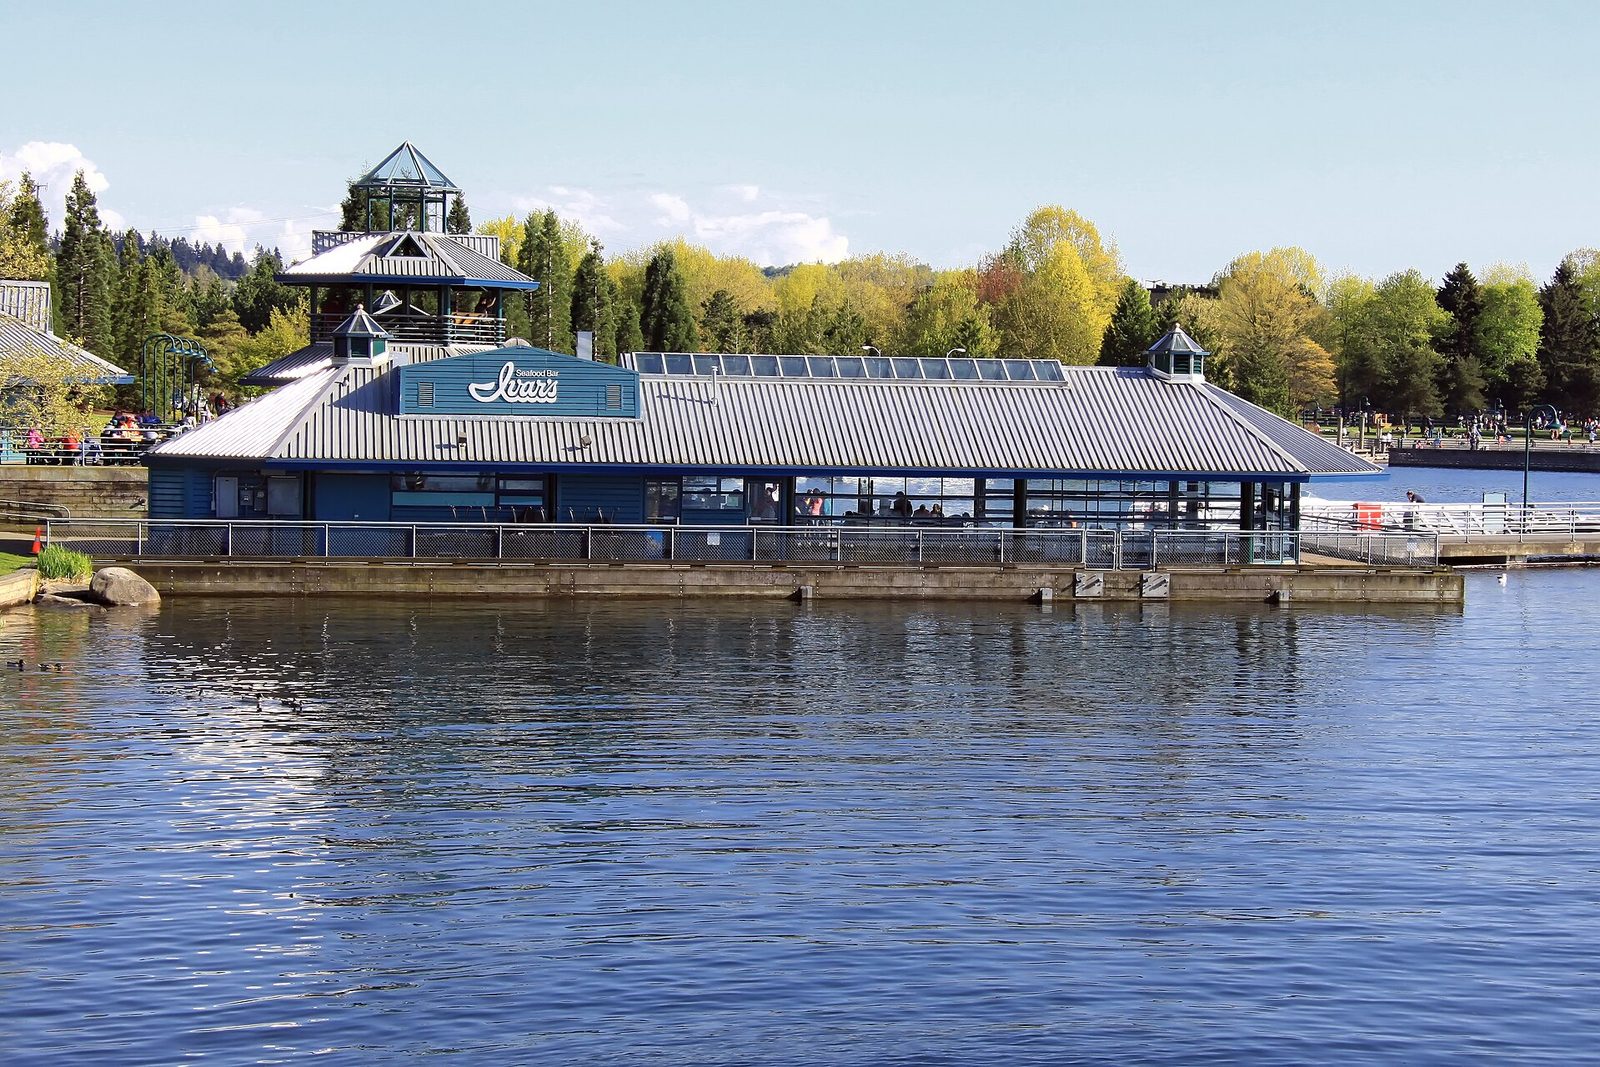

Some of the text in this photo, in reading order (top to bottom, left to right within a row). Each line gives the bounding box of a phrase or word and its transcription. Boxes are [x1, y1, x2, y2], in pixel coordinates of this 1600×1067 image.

[468, 361, 559, 403] Ivar's
[515, 369, 559, 377] Seafood Bar
